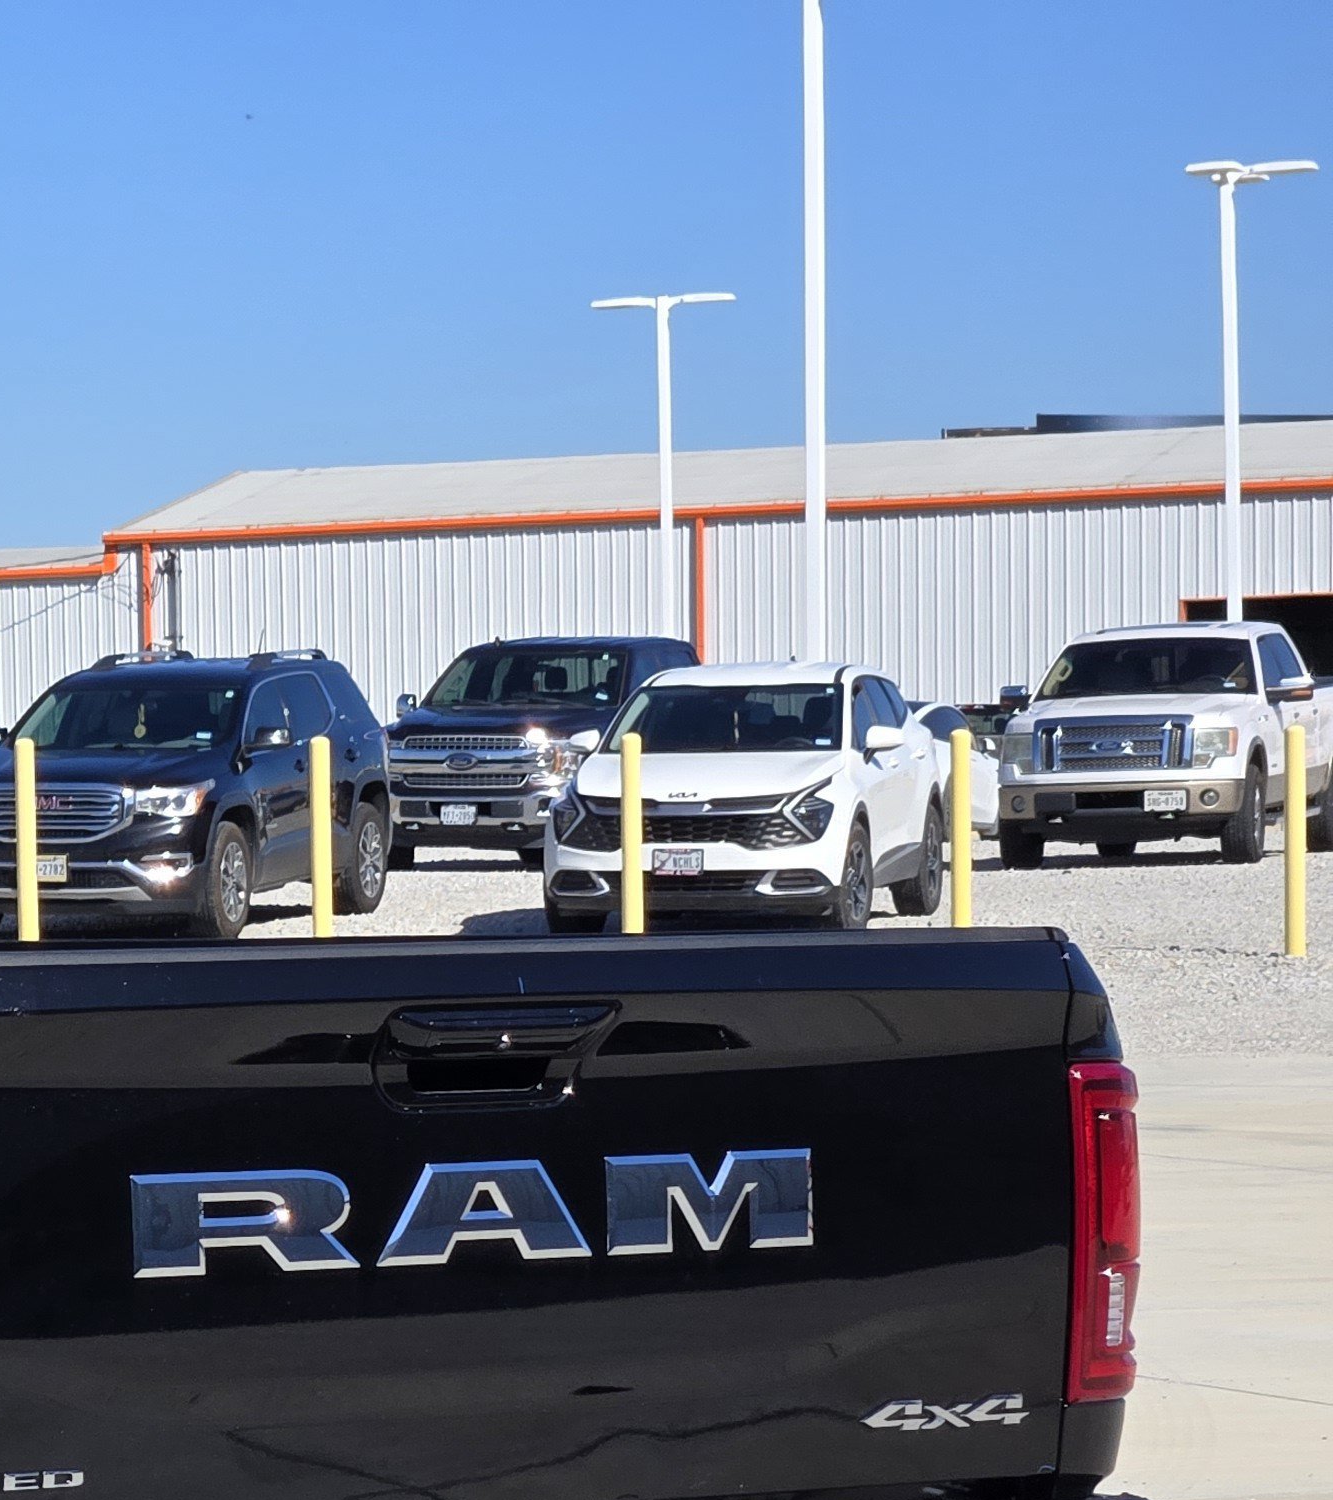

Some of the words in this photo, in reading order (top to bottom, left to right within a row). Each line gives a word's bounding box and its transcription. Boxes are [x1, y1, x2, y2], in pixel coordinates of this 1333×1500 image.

[35, 795, 73, 810] MC
[130, 1148, 814, 1278] RAM
[859, 1393, 1030, 1431] 4x4
